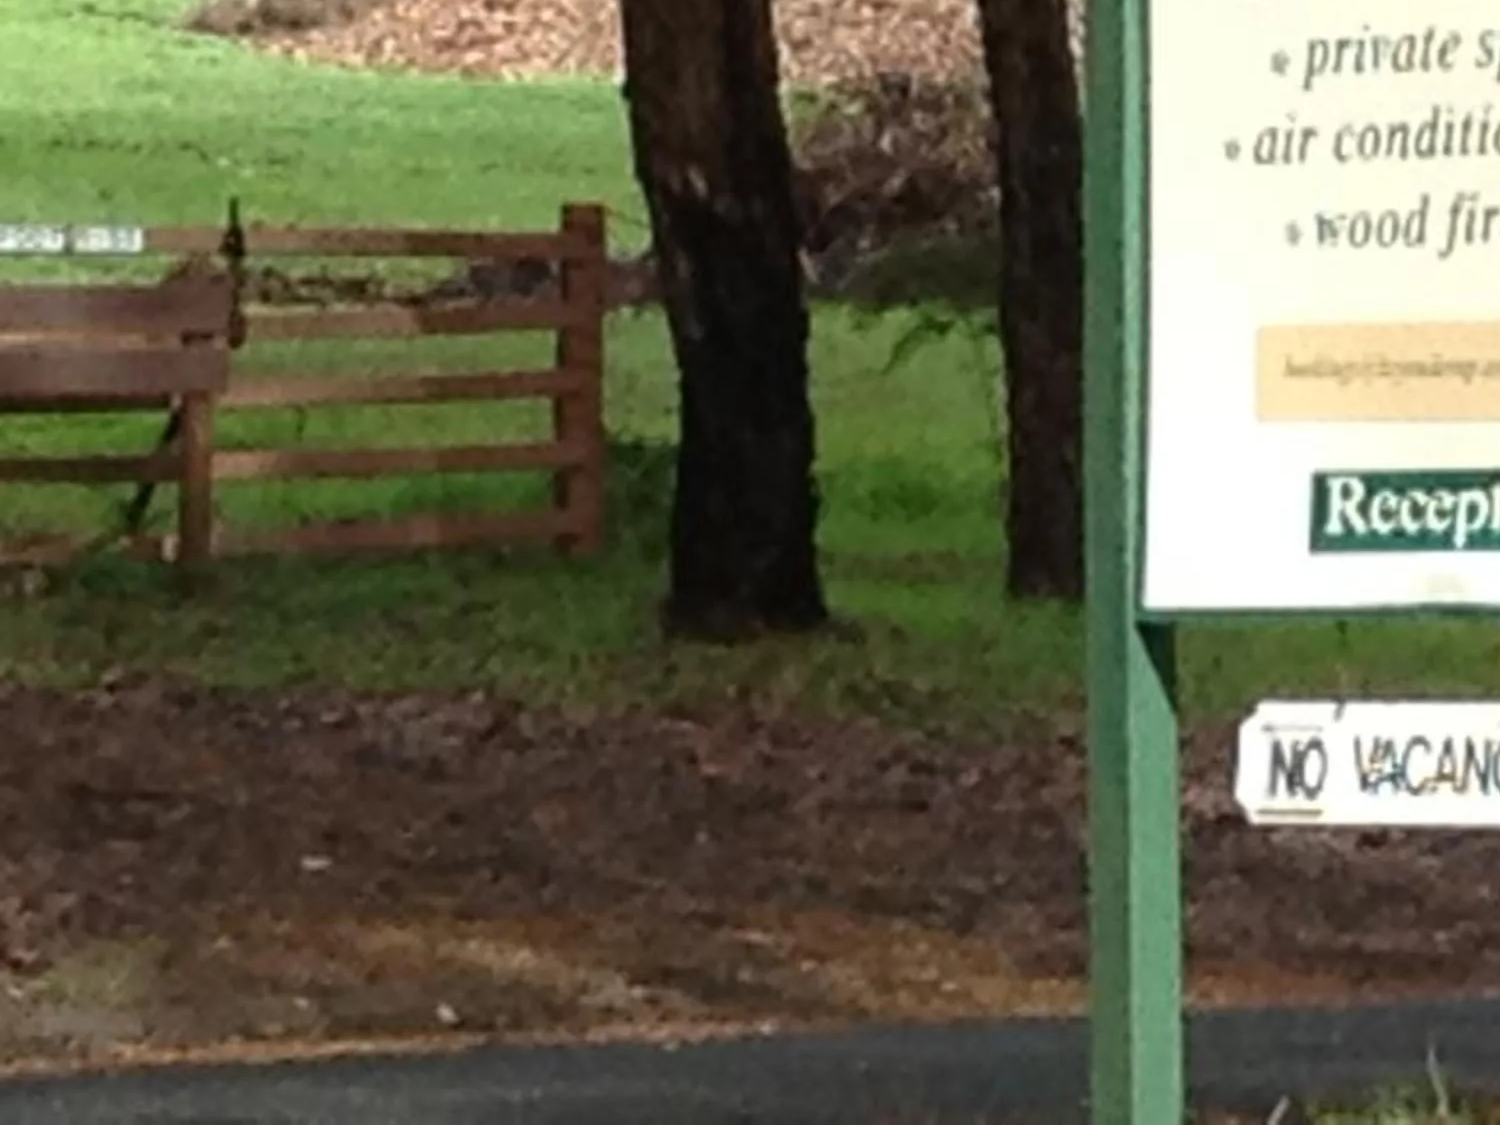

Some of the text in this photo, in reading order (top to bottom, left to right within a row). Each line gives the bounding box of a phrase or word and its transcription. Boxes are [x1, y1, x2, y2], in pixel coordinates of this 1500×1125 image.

[1302, 23, 1462, 91] private
[1253, 111, 1318, 164] air
[1314, 193, 1430, 248] wood
[1267, 736, 1328, 801] NO
